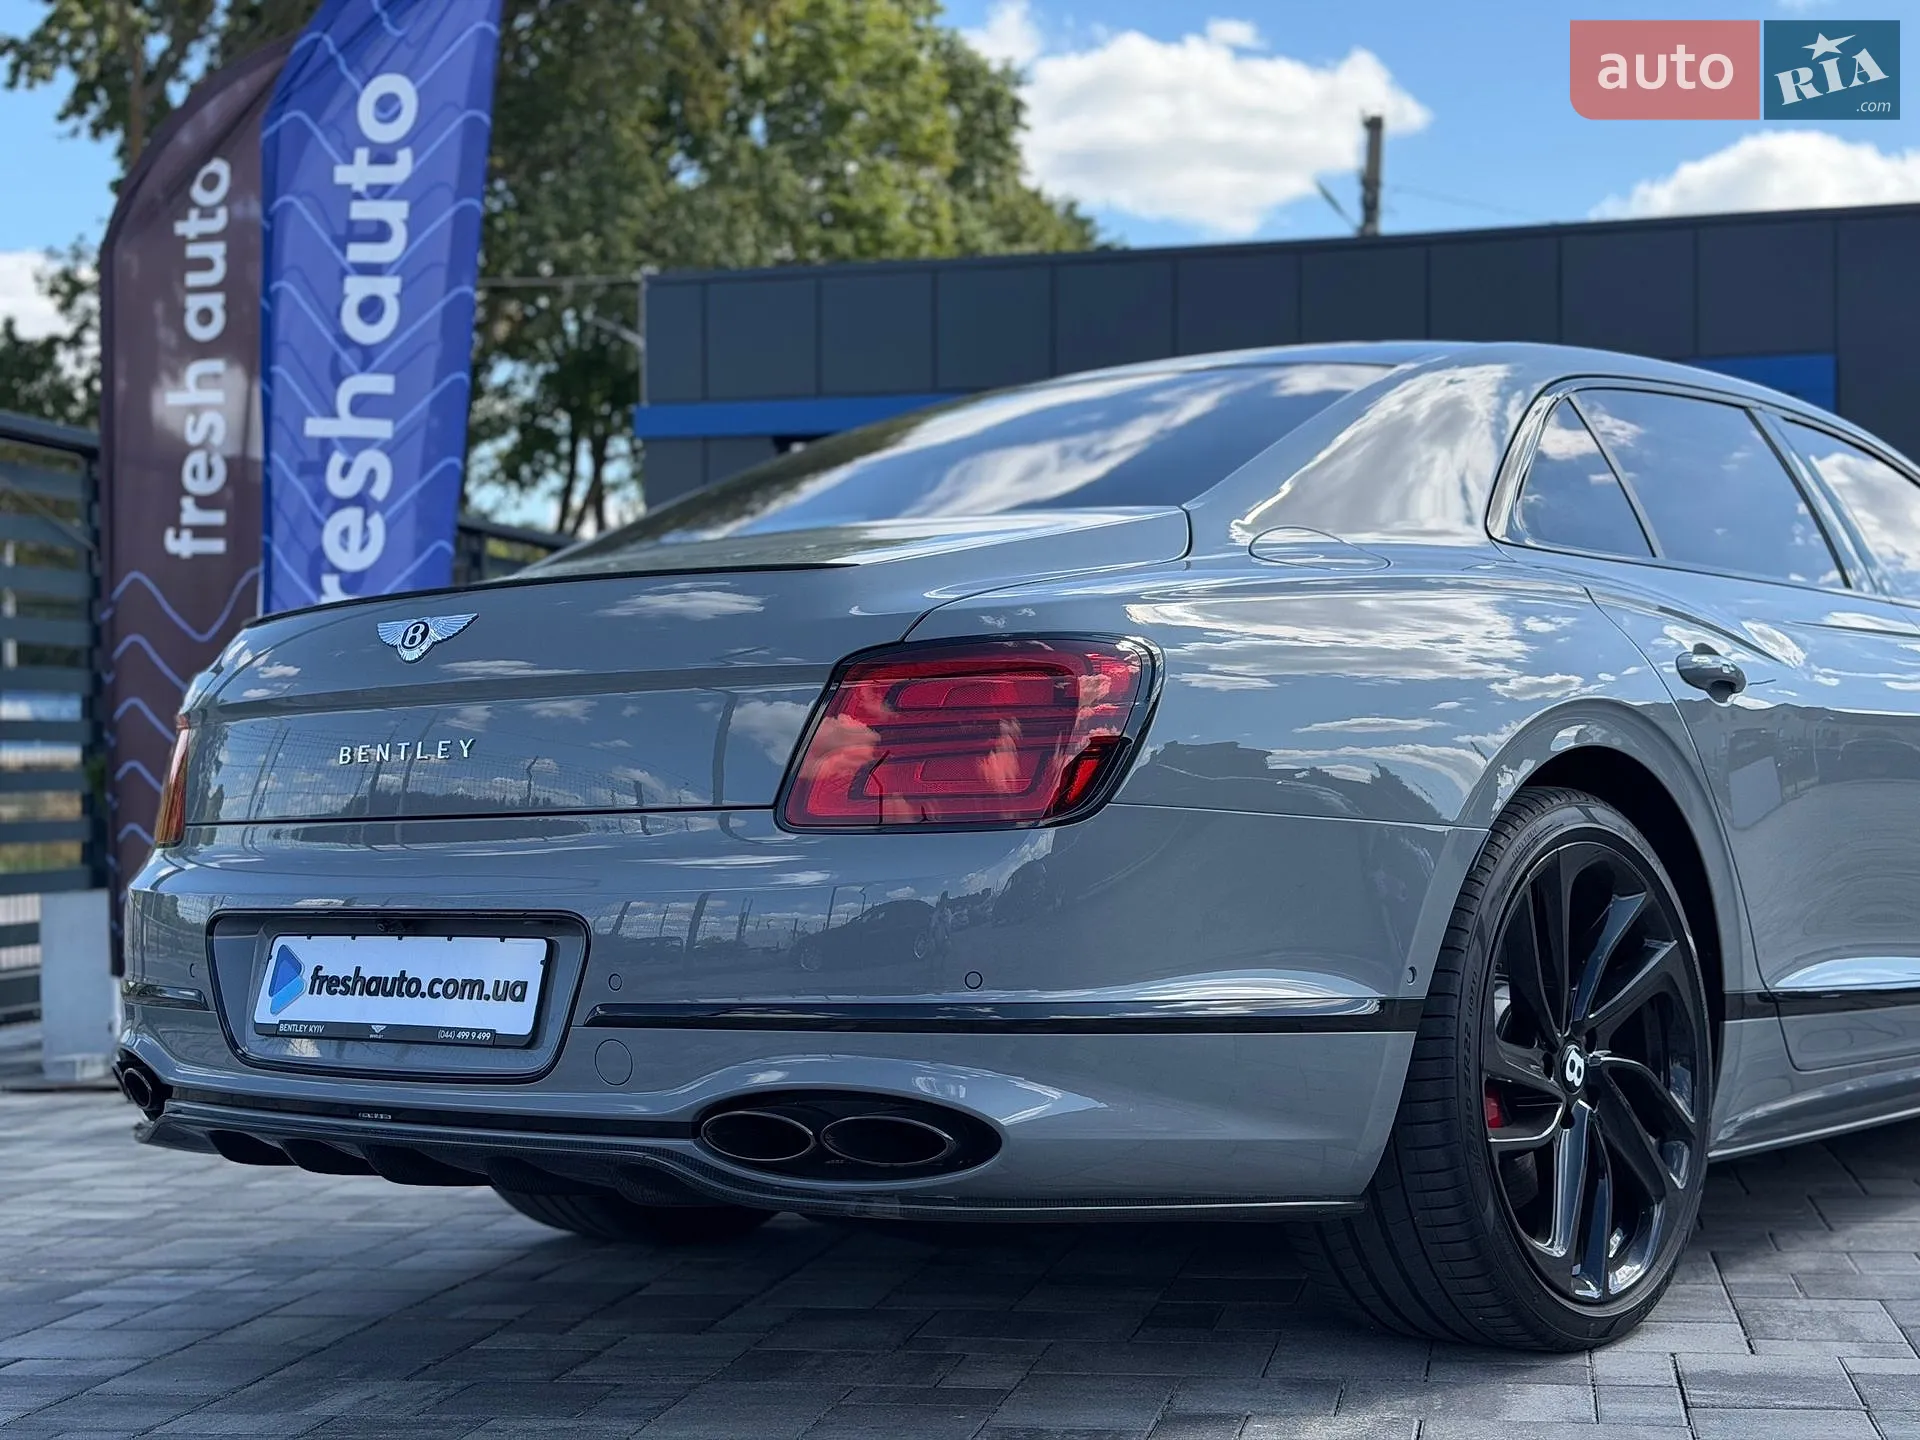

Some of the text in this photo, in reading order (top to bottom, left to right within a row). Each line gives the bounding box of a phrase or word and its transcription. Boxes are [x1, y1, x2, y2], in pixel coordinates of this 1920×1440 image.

[333, 73, 419, 346] auto
[164, 157, 232, 560] fresh auto
[338, 738, 475, 765] BENTLEY
[308, 965, 529, 1002] freshauto.com.ua
[279, 1023, 325, 1034] BENTLEY KYIV
[437, 1029, 492, 1041] (044) 499 9 499
